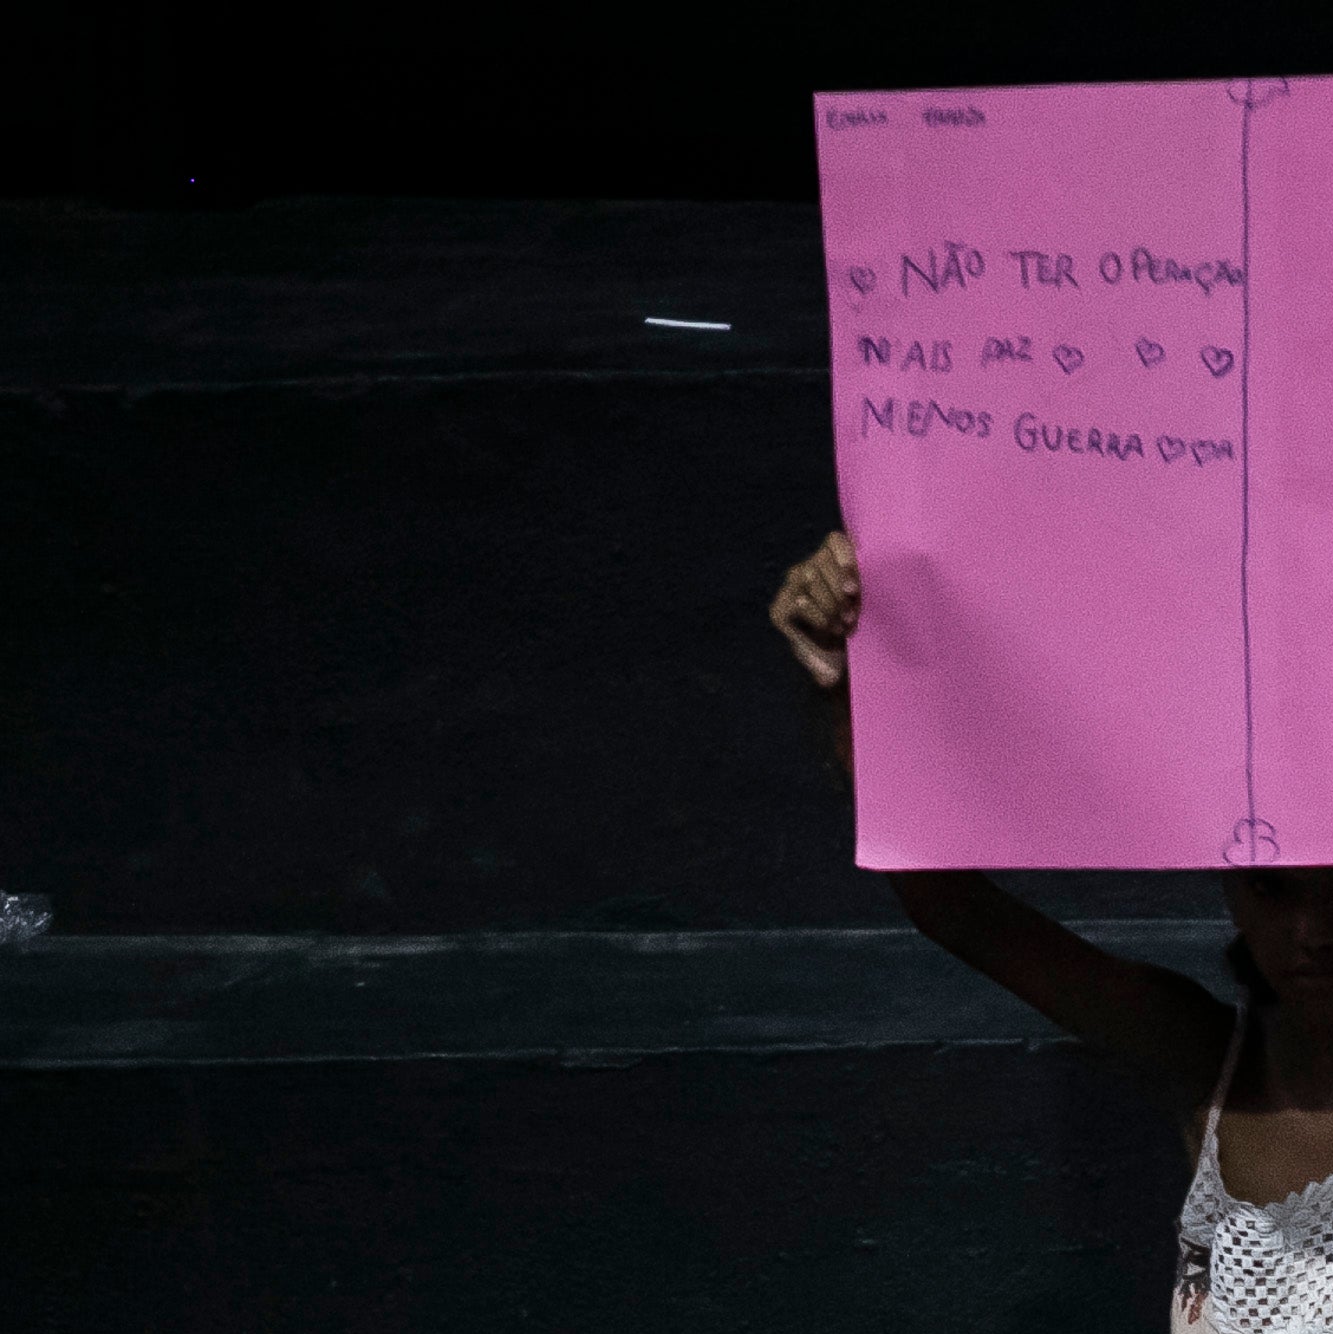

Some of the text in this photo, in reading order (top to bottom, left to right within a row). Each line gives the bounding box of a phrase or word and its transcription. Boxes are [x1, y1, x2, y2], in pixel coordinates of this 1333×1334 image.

[901, 239, 986, 297] NÃO
[1010, 249, 1080, 290] TER
[1013, 411, 1144, 462] GUERRA
